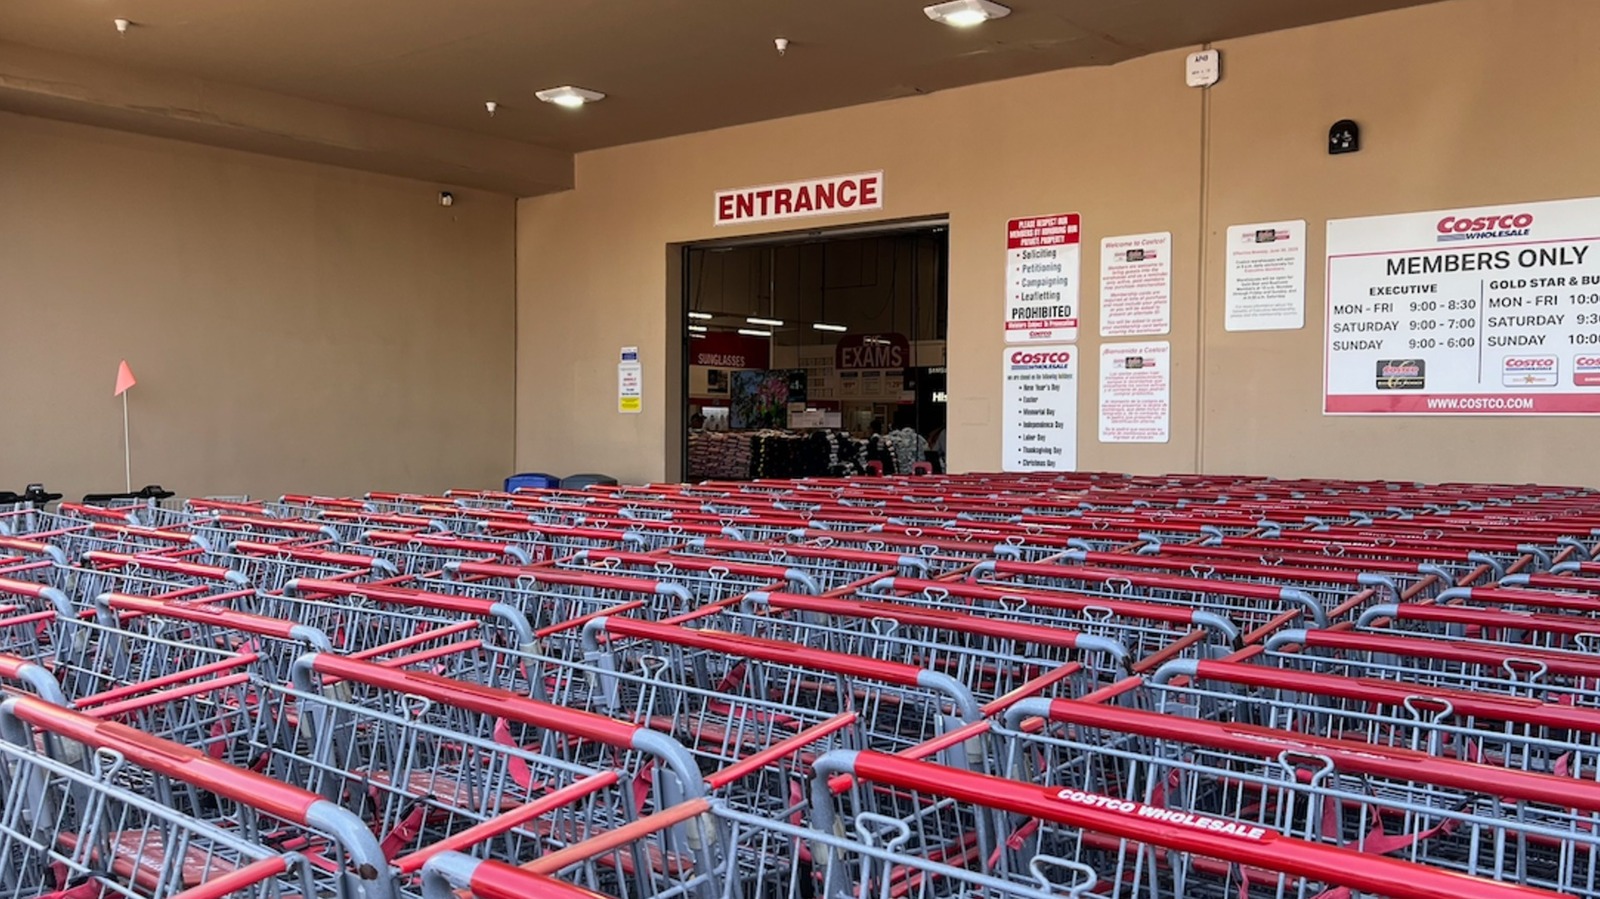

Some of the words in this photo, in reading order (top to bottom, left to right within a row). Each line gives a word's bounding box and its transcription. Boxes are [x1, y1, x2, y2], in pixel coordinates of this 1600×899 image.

[719, 178, 877, 220] ENTRANCE
[1019, 220, 1035, 228] PLEASE
[1436, 213, 1533, 234] COSTCO
[1010, 230, 1033, 238] MEMBERS
[1465, 228, 1530, 240] WHOLESALE
[1022, 249, 1056, 259] Soliciting
[1386, 250, 1510, 276] MEMBERS
[1518, 245, 1589, 268] ONLY
[1022, 263, 1061, 273] Petitioning
[1022, 276, 1068, 288] Campaigning
[1490, 277, 1526, 290] GOLD
[1530, 276, 1565, 288] STAR
[1569, 276, 1579, 286] &
[1369, 284, 1438, 296] EXECUTIVE
[1021, 291, 1060, 302] Leafletting
[1489, 296, 1522, 309] MON
[1535, 295, 1558, 307] FRI
[1012, 305, 1071, 319] PROHIBITED
[1334, 303, 1362, 315] MON
[1374, 302, 1393, 314] FRI
[1409, 300, 1436, 312] 9:00
[1448, 299, 1476, 311] 8:30
[1333, 320, 1399, 333] SATURDAY
[1409, 319, 1436, 331] 9:00
[1448, 318, 1476, 329] 7:00
[1488, 314, 1565, 328] SATURDAY
[1333, 339, 1383, 351] SUNDAY
[1409, 338, 1436, 350] 9:00
[1447, 337, 1475, 348] 6:00
[1488, 335, 1546, 347] SUNDAY
[697, 353, 746, 368] SUNGLASSES
[842, 347, 902, 368] EXAMS
[1011, 352, 1070, 364] COSTCO
[1505, 358, 1554, 368] COSTCO
[1427, 398, 1533, 409] WWW.COSTCO.COM
[1046, 408, 1055, 416] Day
[1037, 434, 1046, 442] Day
[1023, 446, 1052, 455] Thanksgiving
[1053, 446, 1062, 455] Day
[1047, 460, 1055, 468] Day
[1057, 788, 1134, 813] COSTCO
[1138, 804, 1266, 840] WHOLESALE
